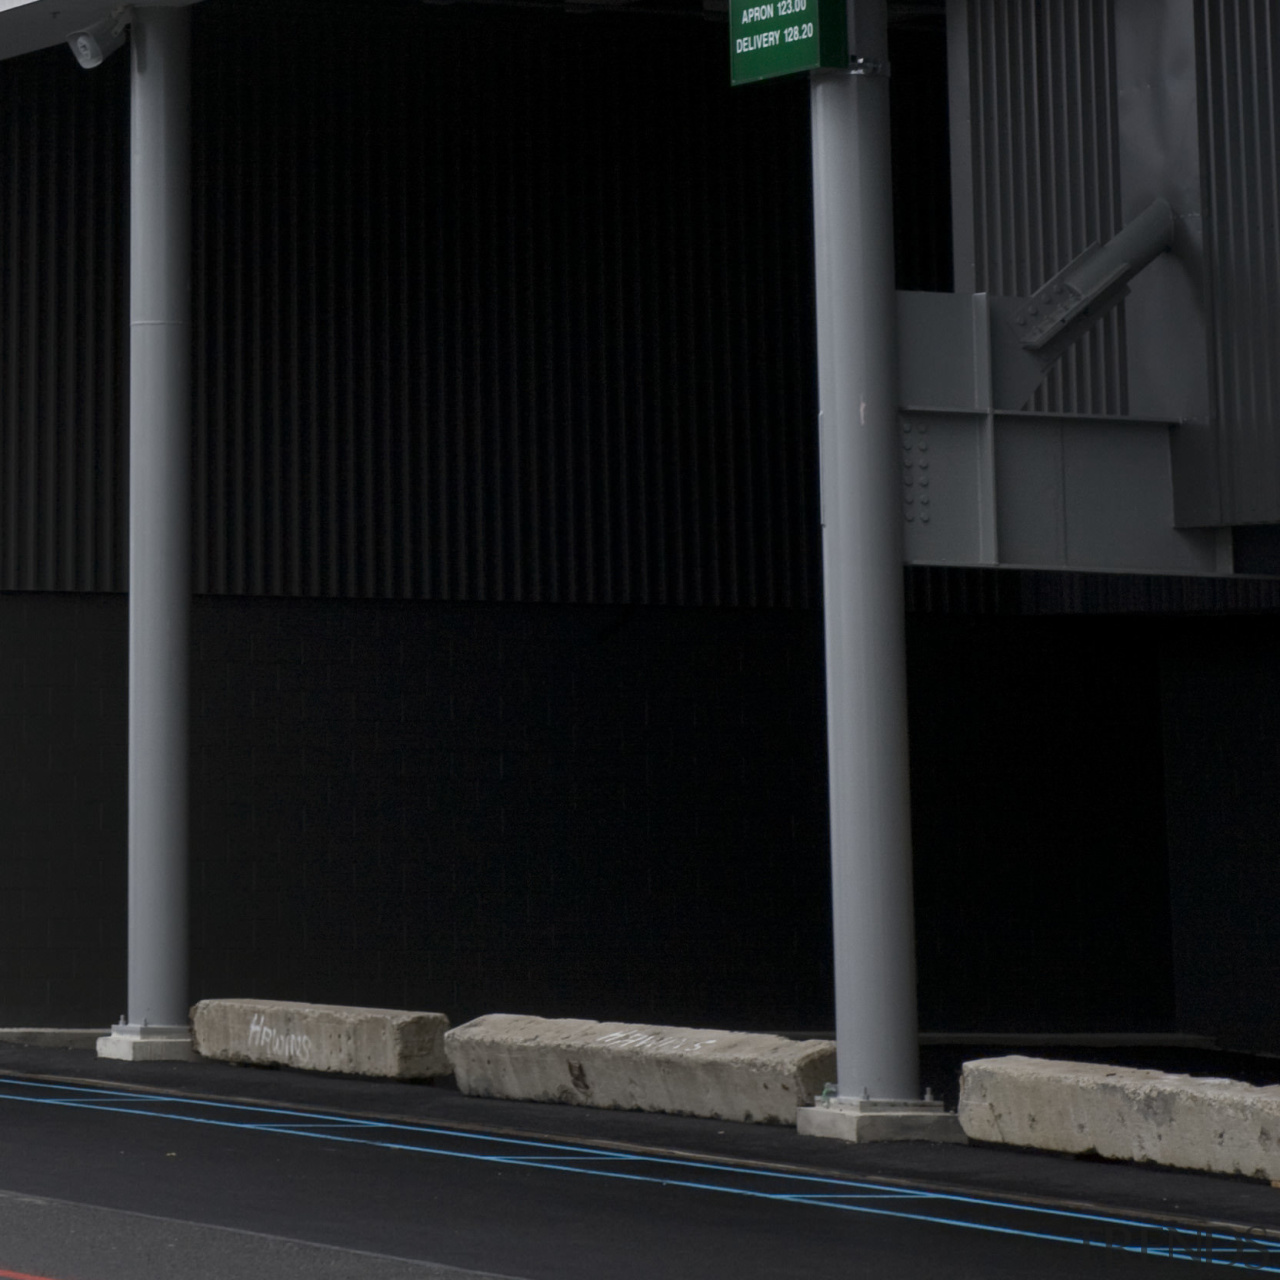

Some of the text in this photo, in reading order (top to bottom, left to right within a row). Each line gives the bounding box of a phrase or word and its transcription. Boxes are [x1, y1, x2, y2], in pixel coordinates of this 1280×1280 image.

[741, 4, 774, 25] APRON
[736, 23, 814, 54] DELIVERY 128.20
